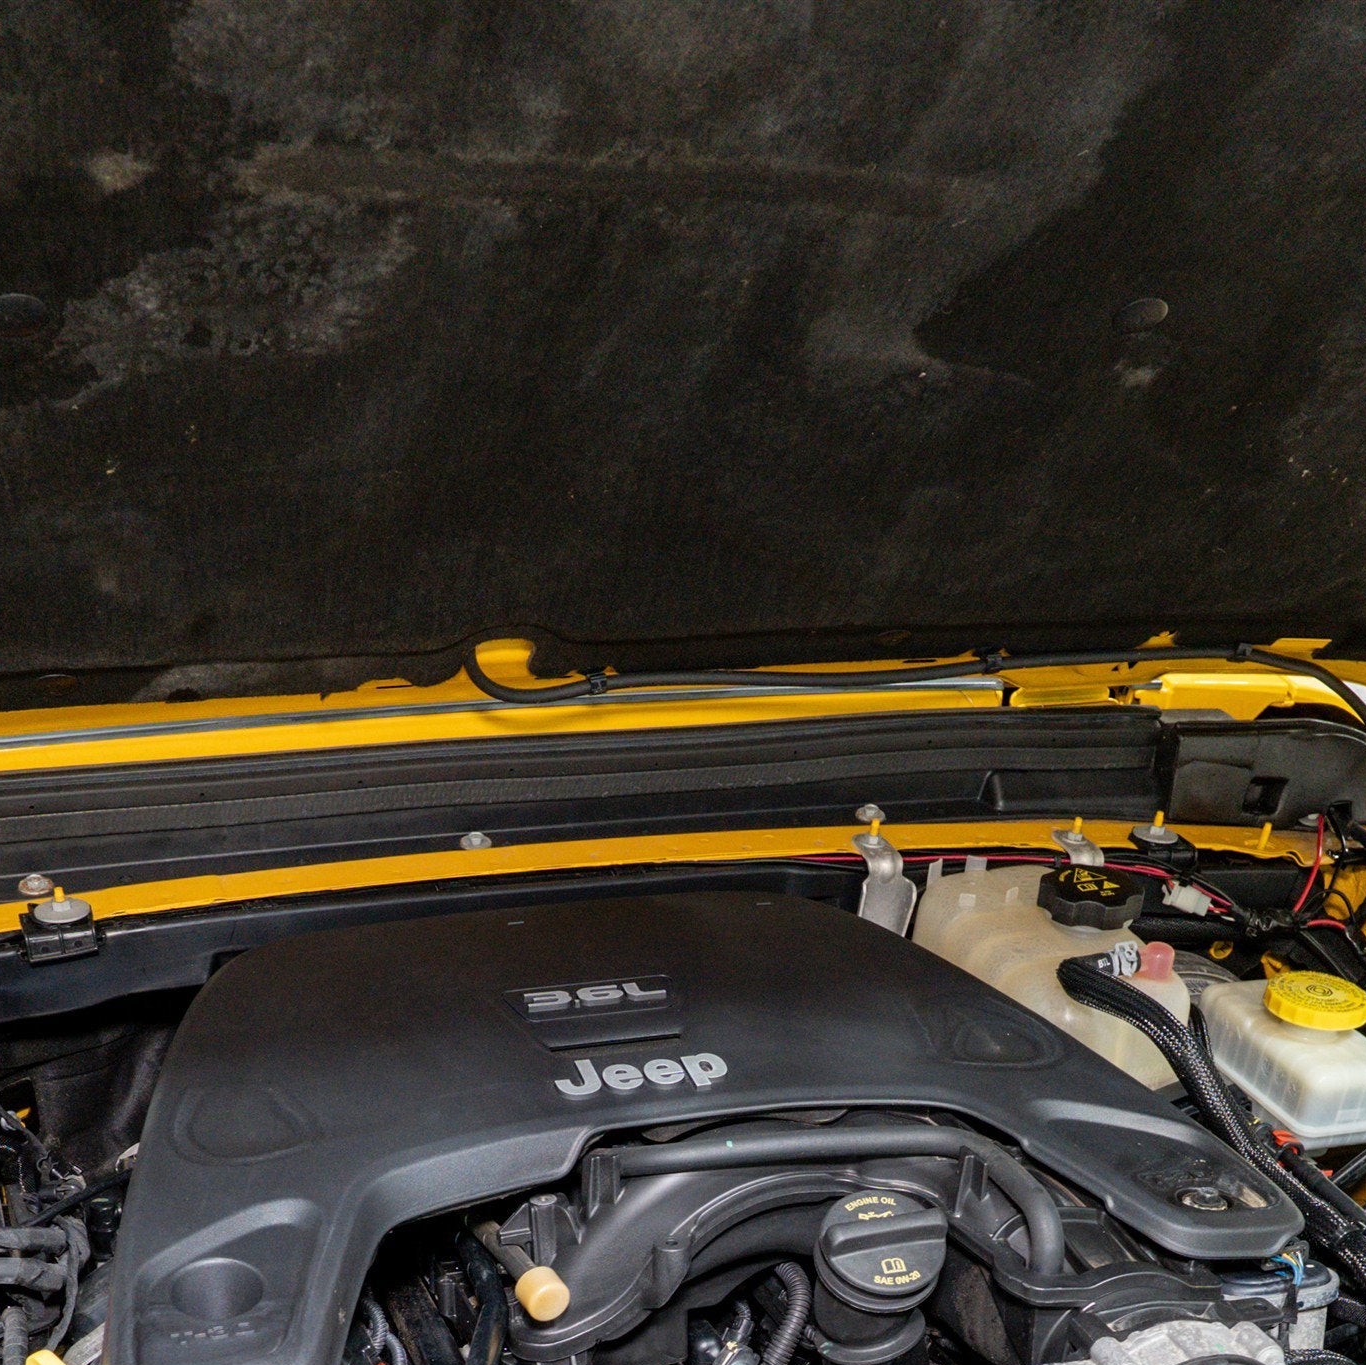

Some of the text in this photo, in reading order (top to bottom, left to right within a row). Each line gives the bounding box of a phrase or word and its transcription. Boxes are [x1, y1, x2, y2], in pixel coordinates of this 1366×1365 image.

[523, 982, 667, 1013] 3.6L
[554, 1052, 728, 1100] Jeep
[844, 1196, 897, 1212] ENGINE OIL
[874, 1270, 921, 1285] SAE 0W-20
